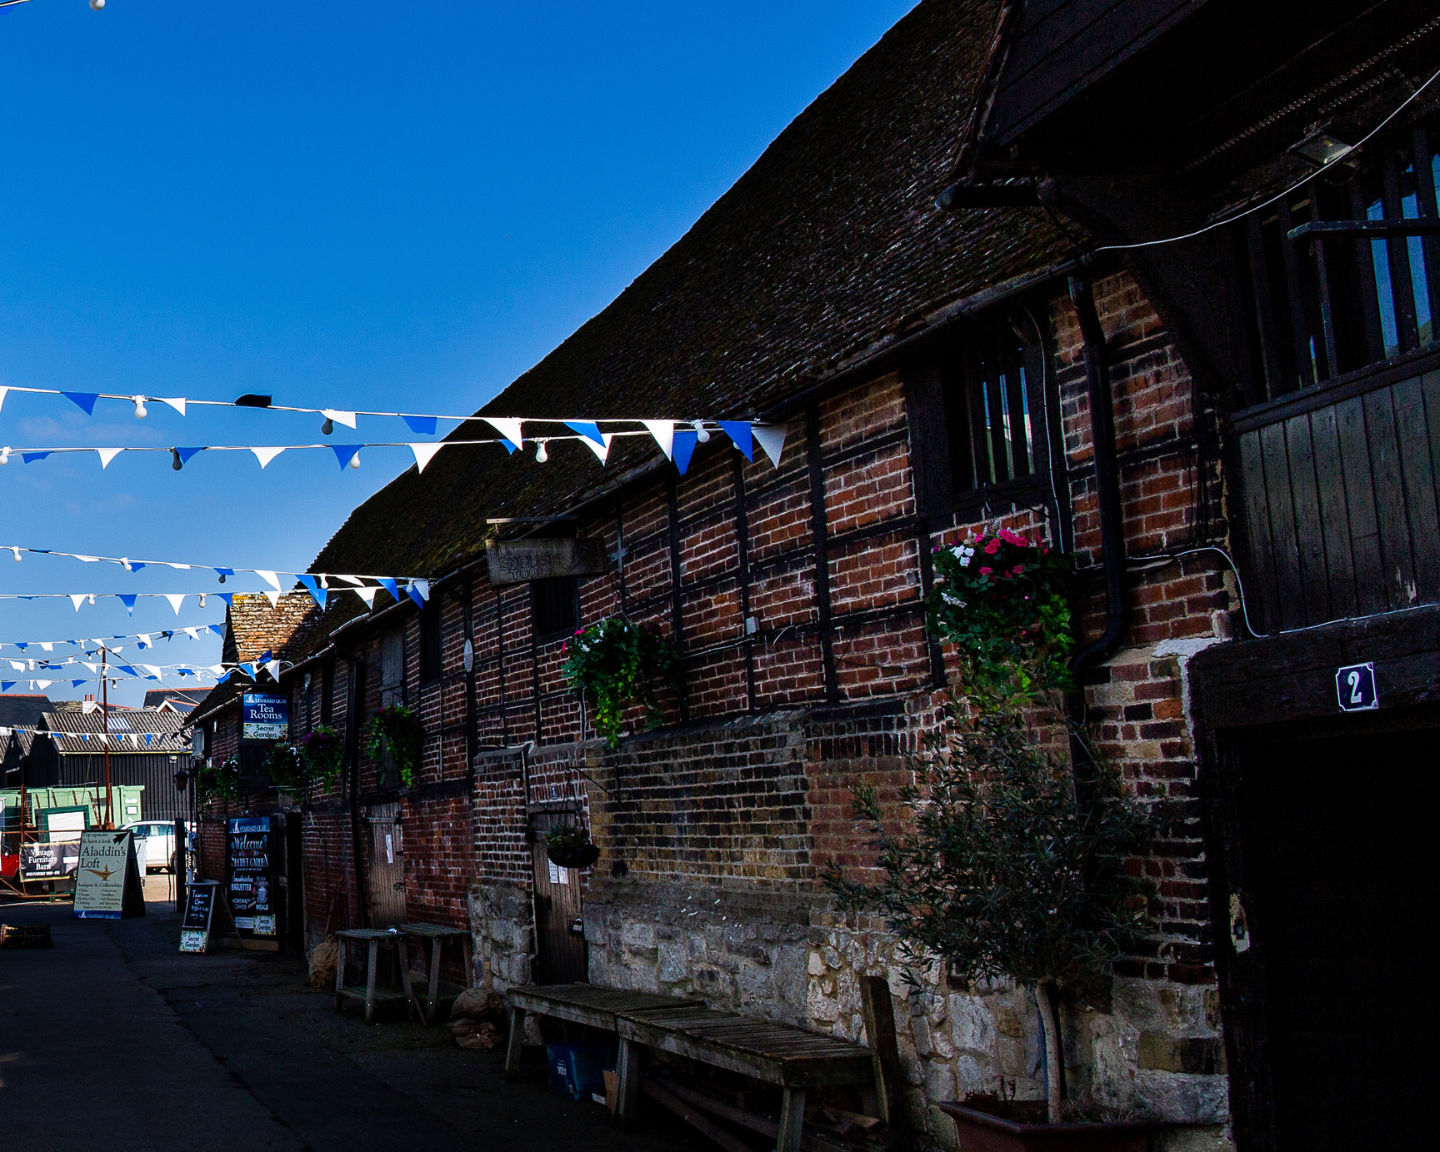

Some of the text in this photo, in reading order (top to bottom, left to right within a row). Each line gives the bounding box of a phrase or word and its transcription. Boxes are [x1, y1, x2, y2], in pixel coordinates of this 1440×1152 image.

[499, 554, 560, 571] ENGLISH
[509, 568, 556, 580] TOOLS
[1347, 671, 1363, 704] 2
[257, 703, 274, 713] Tea
[250, 709, 283, 719] Rooms
[233, 834, 264, 850] Welcome
[81, 846, 126, 856] Aladdin's
[28, 856, 58, 864] Furniture
[80, 857, 100, 868] Loft
[231, 853, 269, 867] SECRET GARDEN
[231, 883, 252, 891] BAGUETTES
